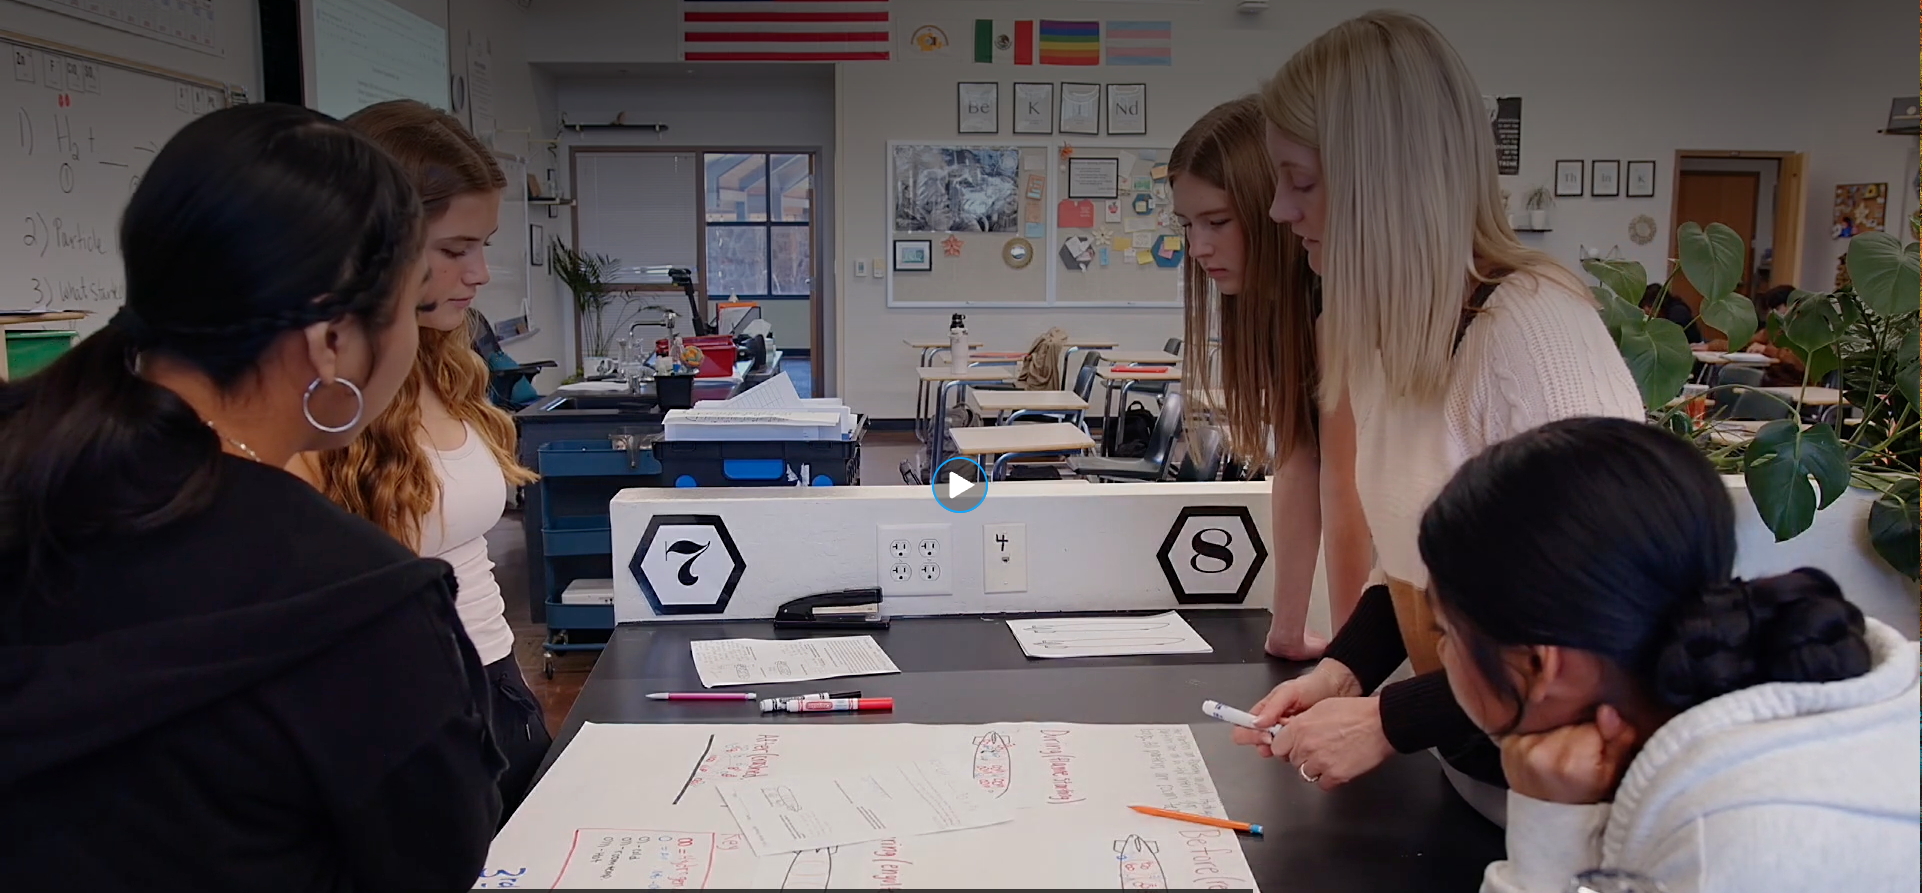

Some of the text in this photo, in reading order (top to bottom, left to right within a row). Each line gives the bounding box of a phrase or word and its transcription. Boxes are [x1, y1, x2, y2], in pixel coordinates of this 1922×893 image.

[968, 101, 990, 114] Be
[1028, 101, 1040, 115] K
[1115, 101, 1139, 116] Nd
[1565, 173, 1577, 183] Th
[23, 211, 49, 258] 2)
[53, 217, 107, 255] Particle
[31, 277, 53, 307] 3)
[995, 533, 1009, 552] 4
[1190, 528, 1234, 574] 8
[665, 540, 711, 586] 7
[716, 833, 740, 851] Key
[1178, 829, 1233, 875] Before
